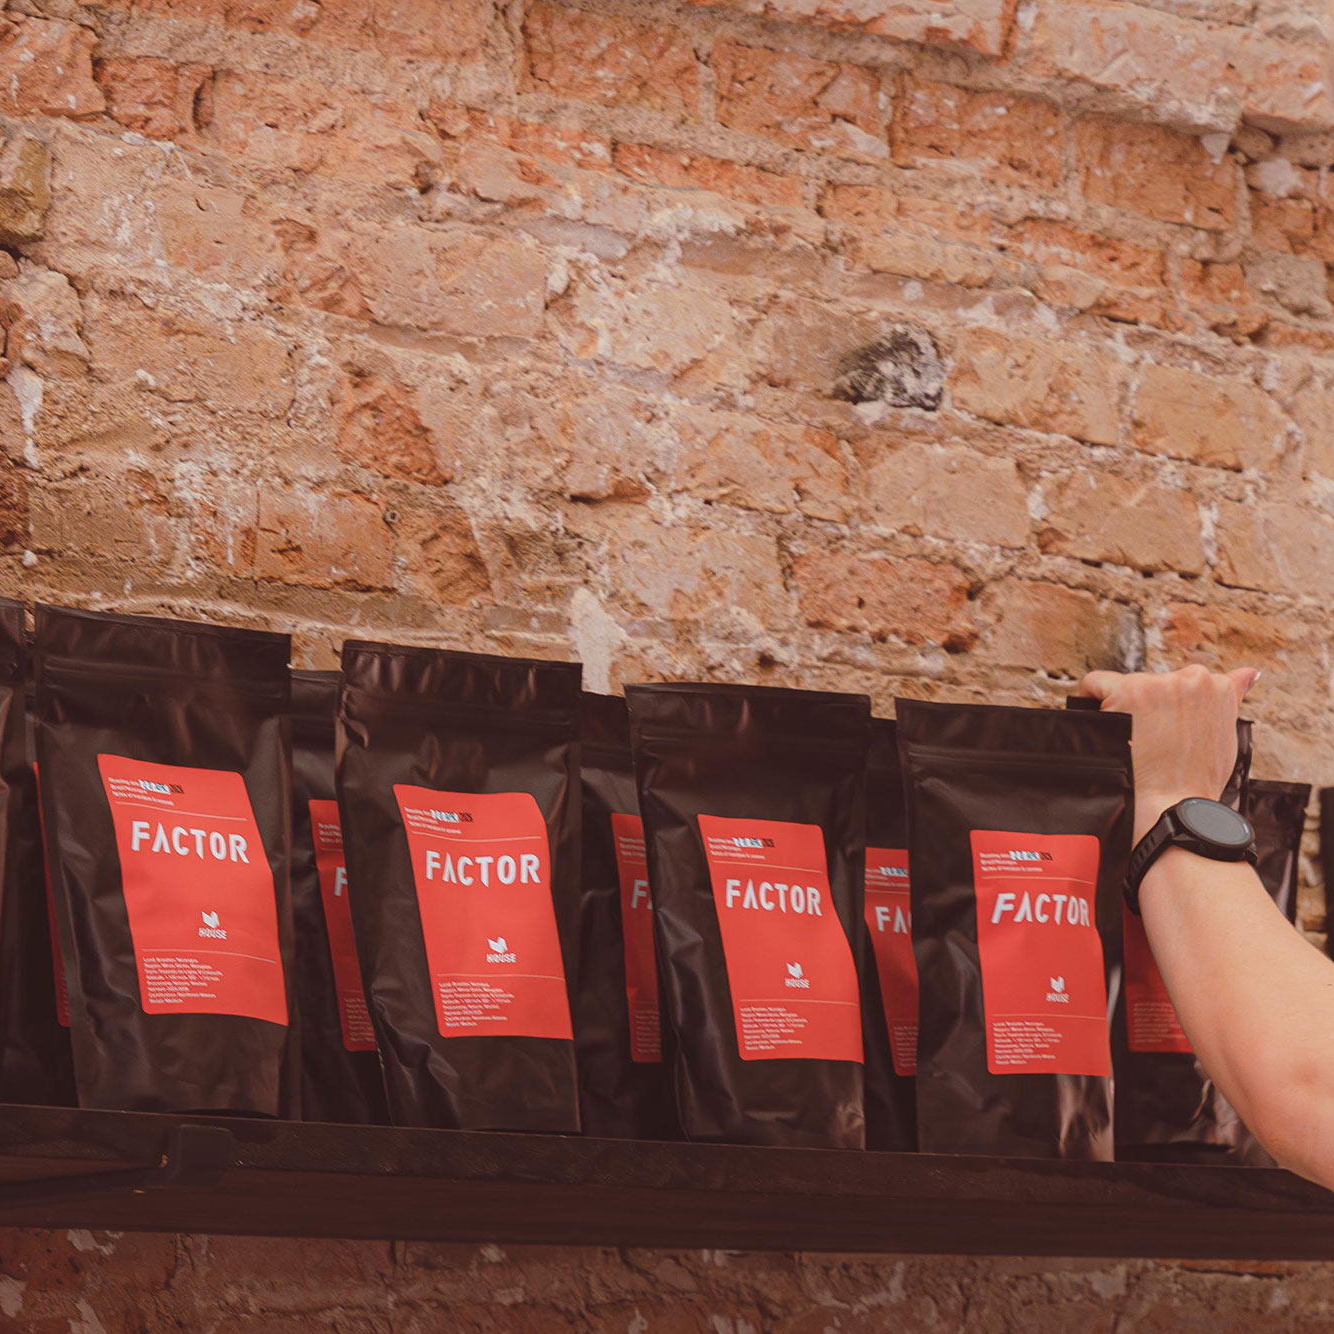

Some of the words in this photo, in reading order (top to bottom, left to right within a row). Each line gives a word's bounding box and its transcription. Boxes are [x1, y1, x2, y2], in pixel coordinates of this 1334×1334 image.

[131, 820, 250, 864] FACTOR
[425, 850, 542, 888] FACTOR
[726, 878, 823, 917] FACTOR
[991, 890, 1091, 928] FACTOR
[198, 927, 228, 941] HOUSE
[485, 952, 517, 964] HOUSE
[784, 977, 811, 990] HOUSE
[1045, 991, 1071, 1004] HOUSE
